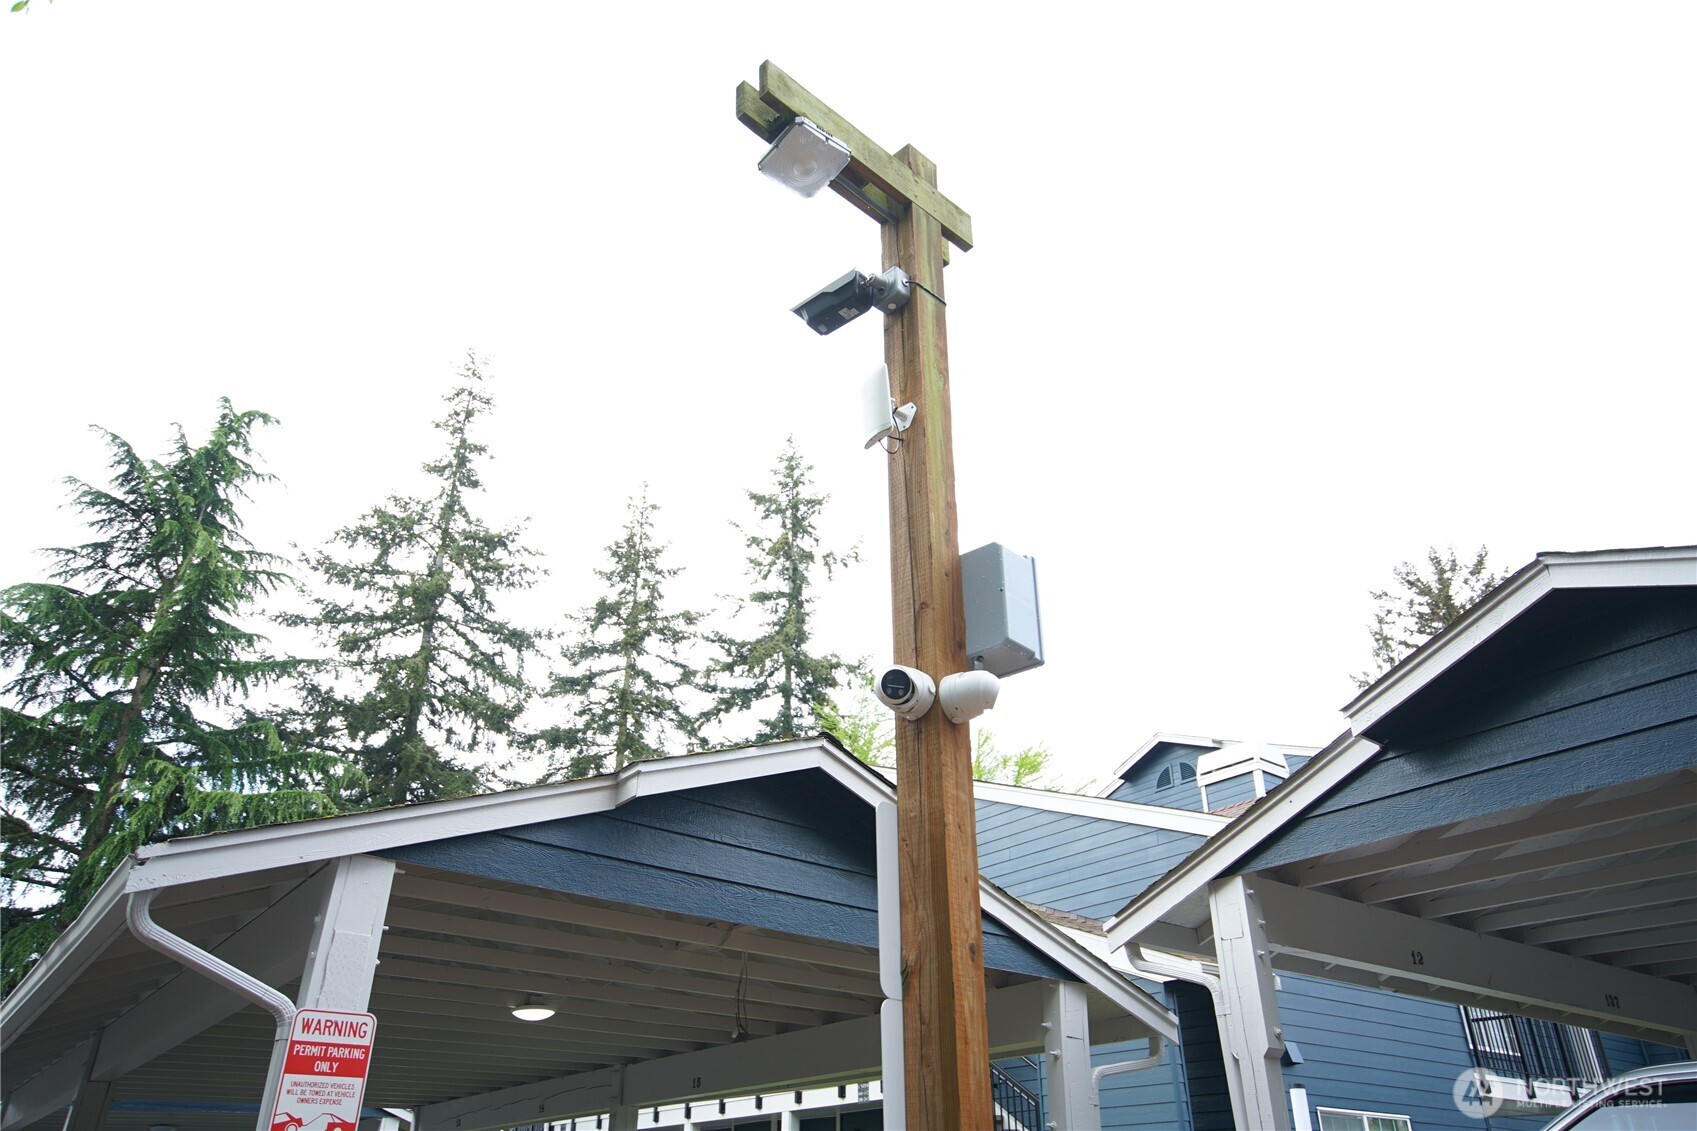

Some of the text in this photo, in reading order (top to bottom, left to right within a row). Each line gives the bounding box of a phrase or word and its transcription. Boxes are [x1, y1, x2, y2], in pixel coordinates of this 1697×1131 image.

[1411, 950, 1424, 965] 12
[301, 1017, 368, 1039] WARNING
[293, 1044, 366, 1059] PERMIT PARKING
[314, 1060, 339, 1073] ONLY
[291, 1081, 355, 1090] UNAUTHORIZED VEHICLES
[692, 1076, 701, 1088] 15
[308, 1089, 326, 1097] TOWED
[334, 1091, 356, 1099] VEHICLE
[296, 1097, 342, 1106] OWNERS EXPENSE
